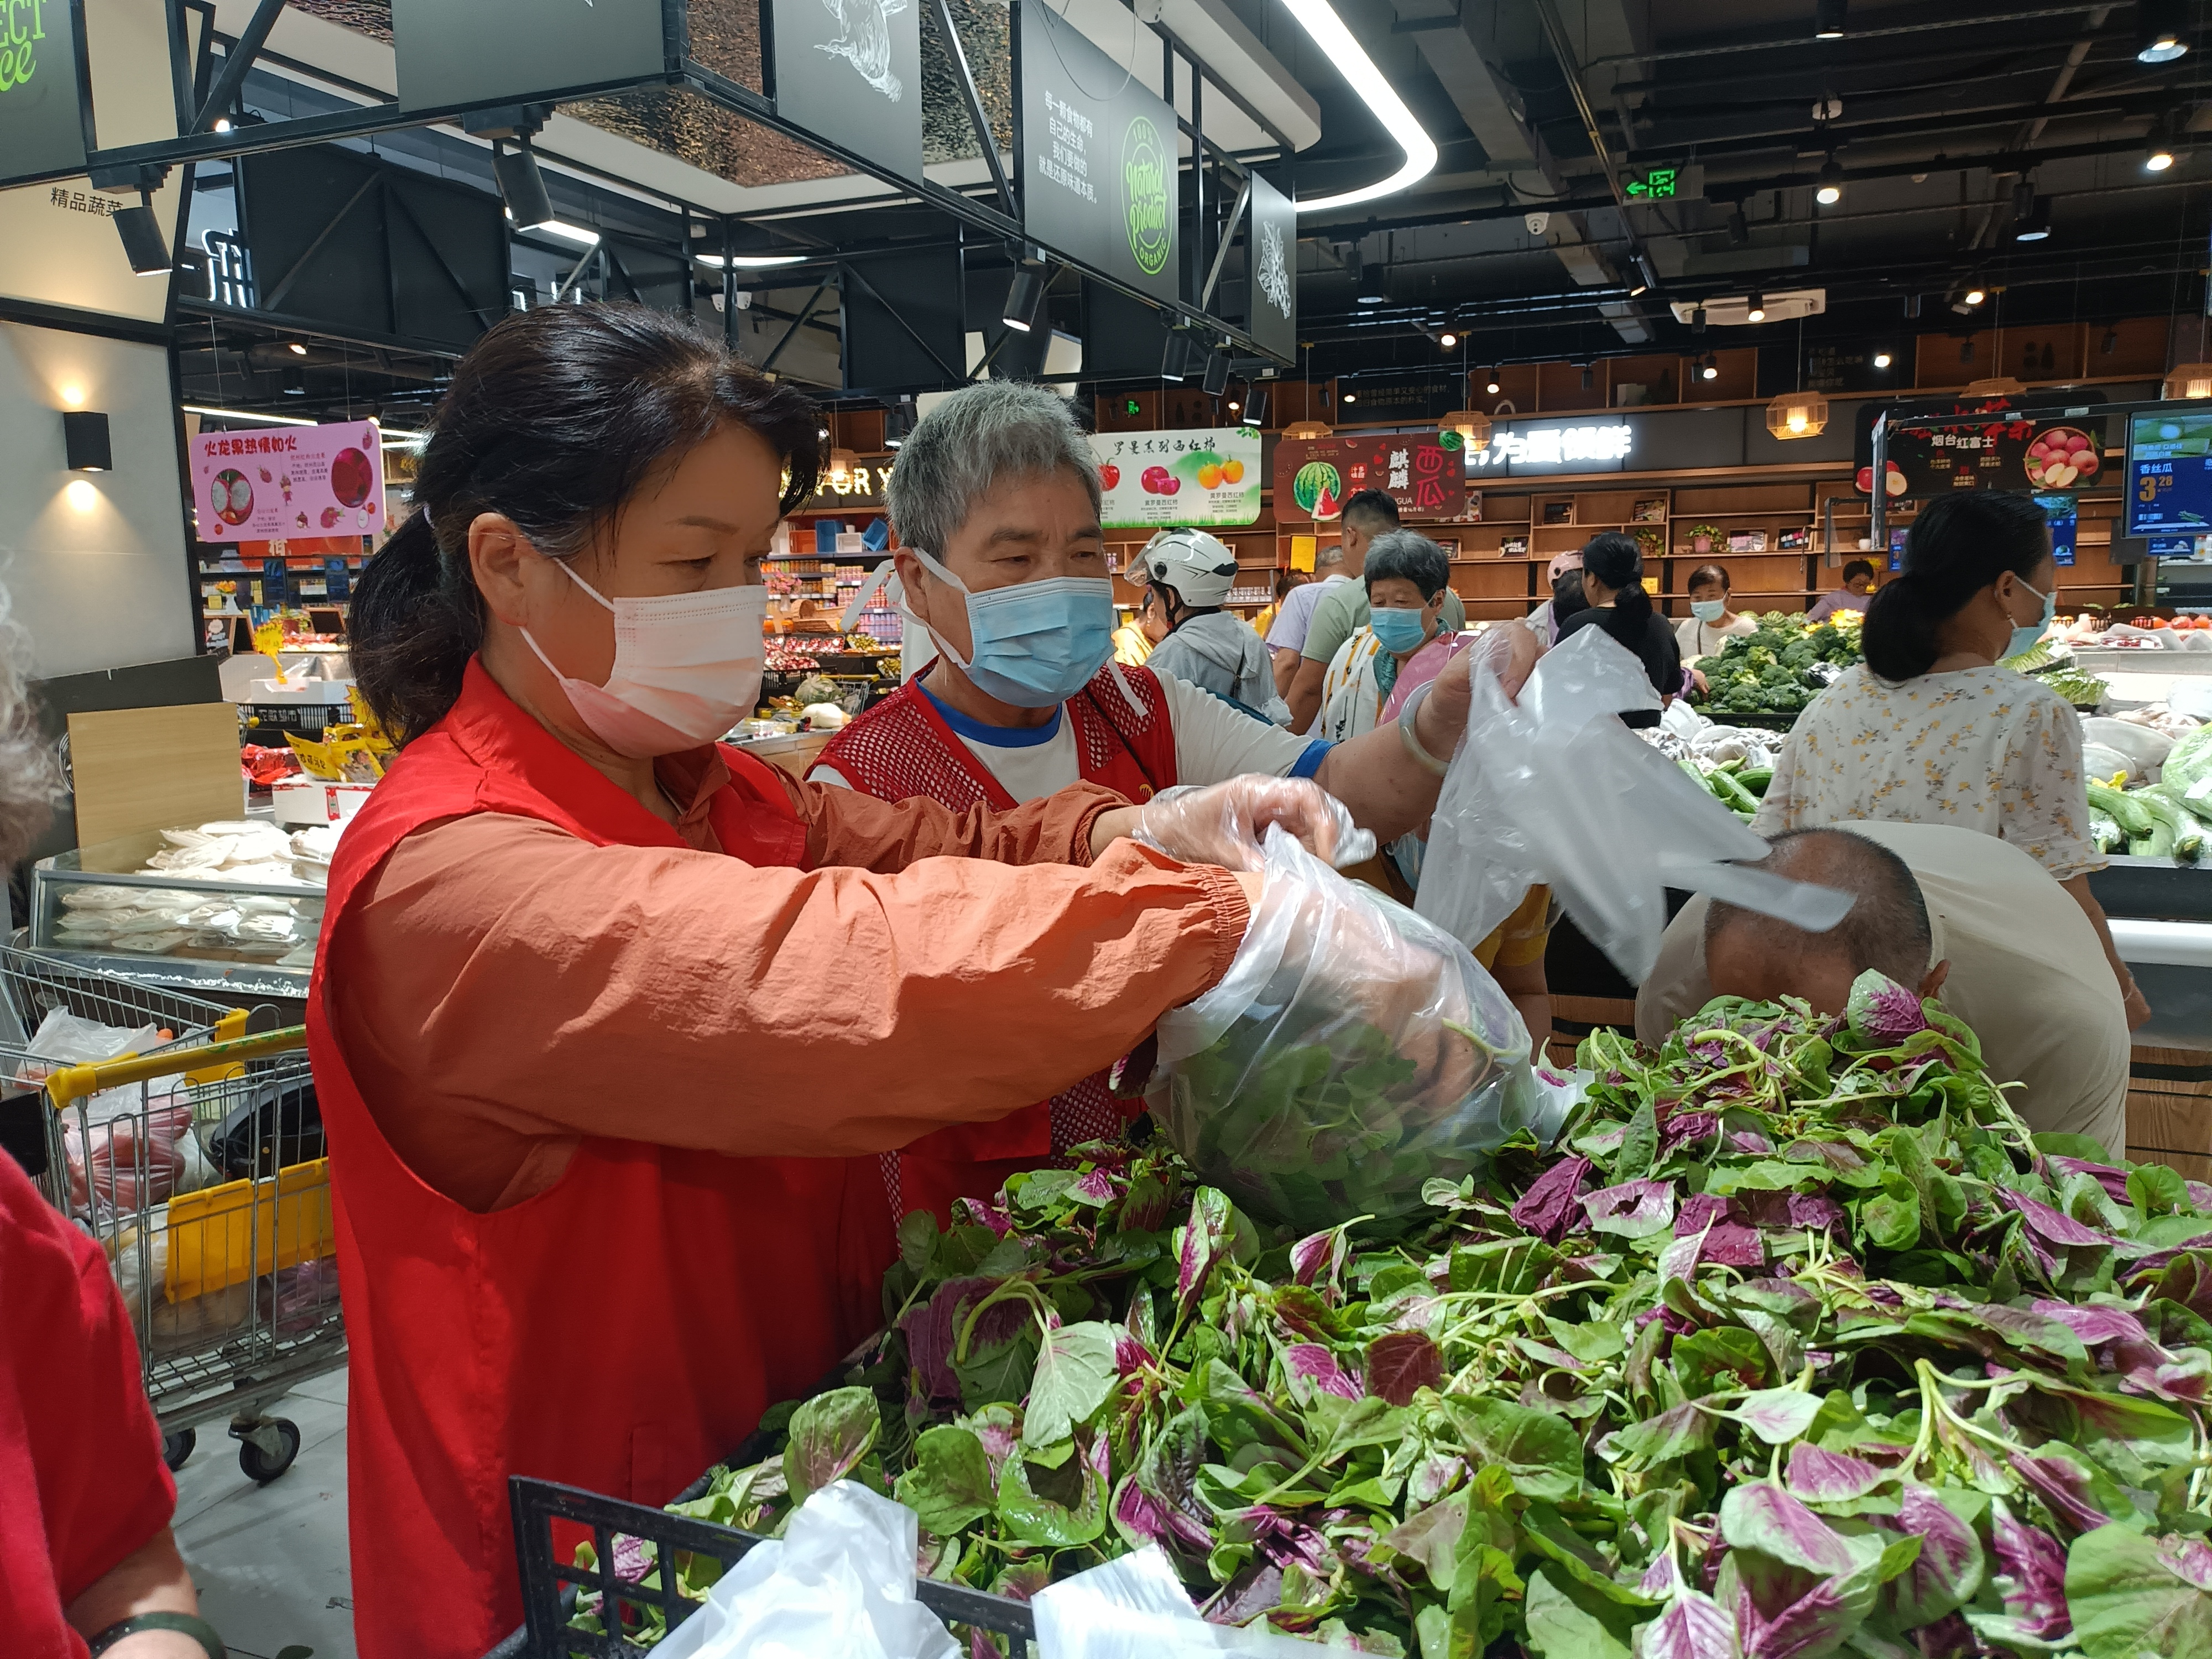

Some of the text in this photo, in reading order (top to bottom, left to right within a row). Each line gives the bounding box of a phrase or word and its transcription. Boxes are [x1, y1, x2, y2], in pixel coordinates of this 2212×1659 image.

[1045, 90, 1093, 138] 每一颗食物都有
[1134, 124, 1152, 145] 100%
[1053, 140, 1087, 177] 我们要做的
[50, 186, 123, 217] 精品蔬菜
[1139, 237, 1167, 267] ORGANIC
[205, 435, 297, 457] 火龙果热情如火
[1932, 434, 1995, 449] 烟台红富士
[1387, 448, 1410, 489] 麒麟
[1415, 445, 1447, 507] 西瓜
[2140, 462, 2173, 474] 香丝瓜
[2139, 476, 2156, 502] 3
